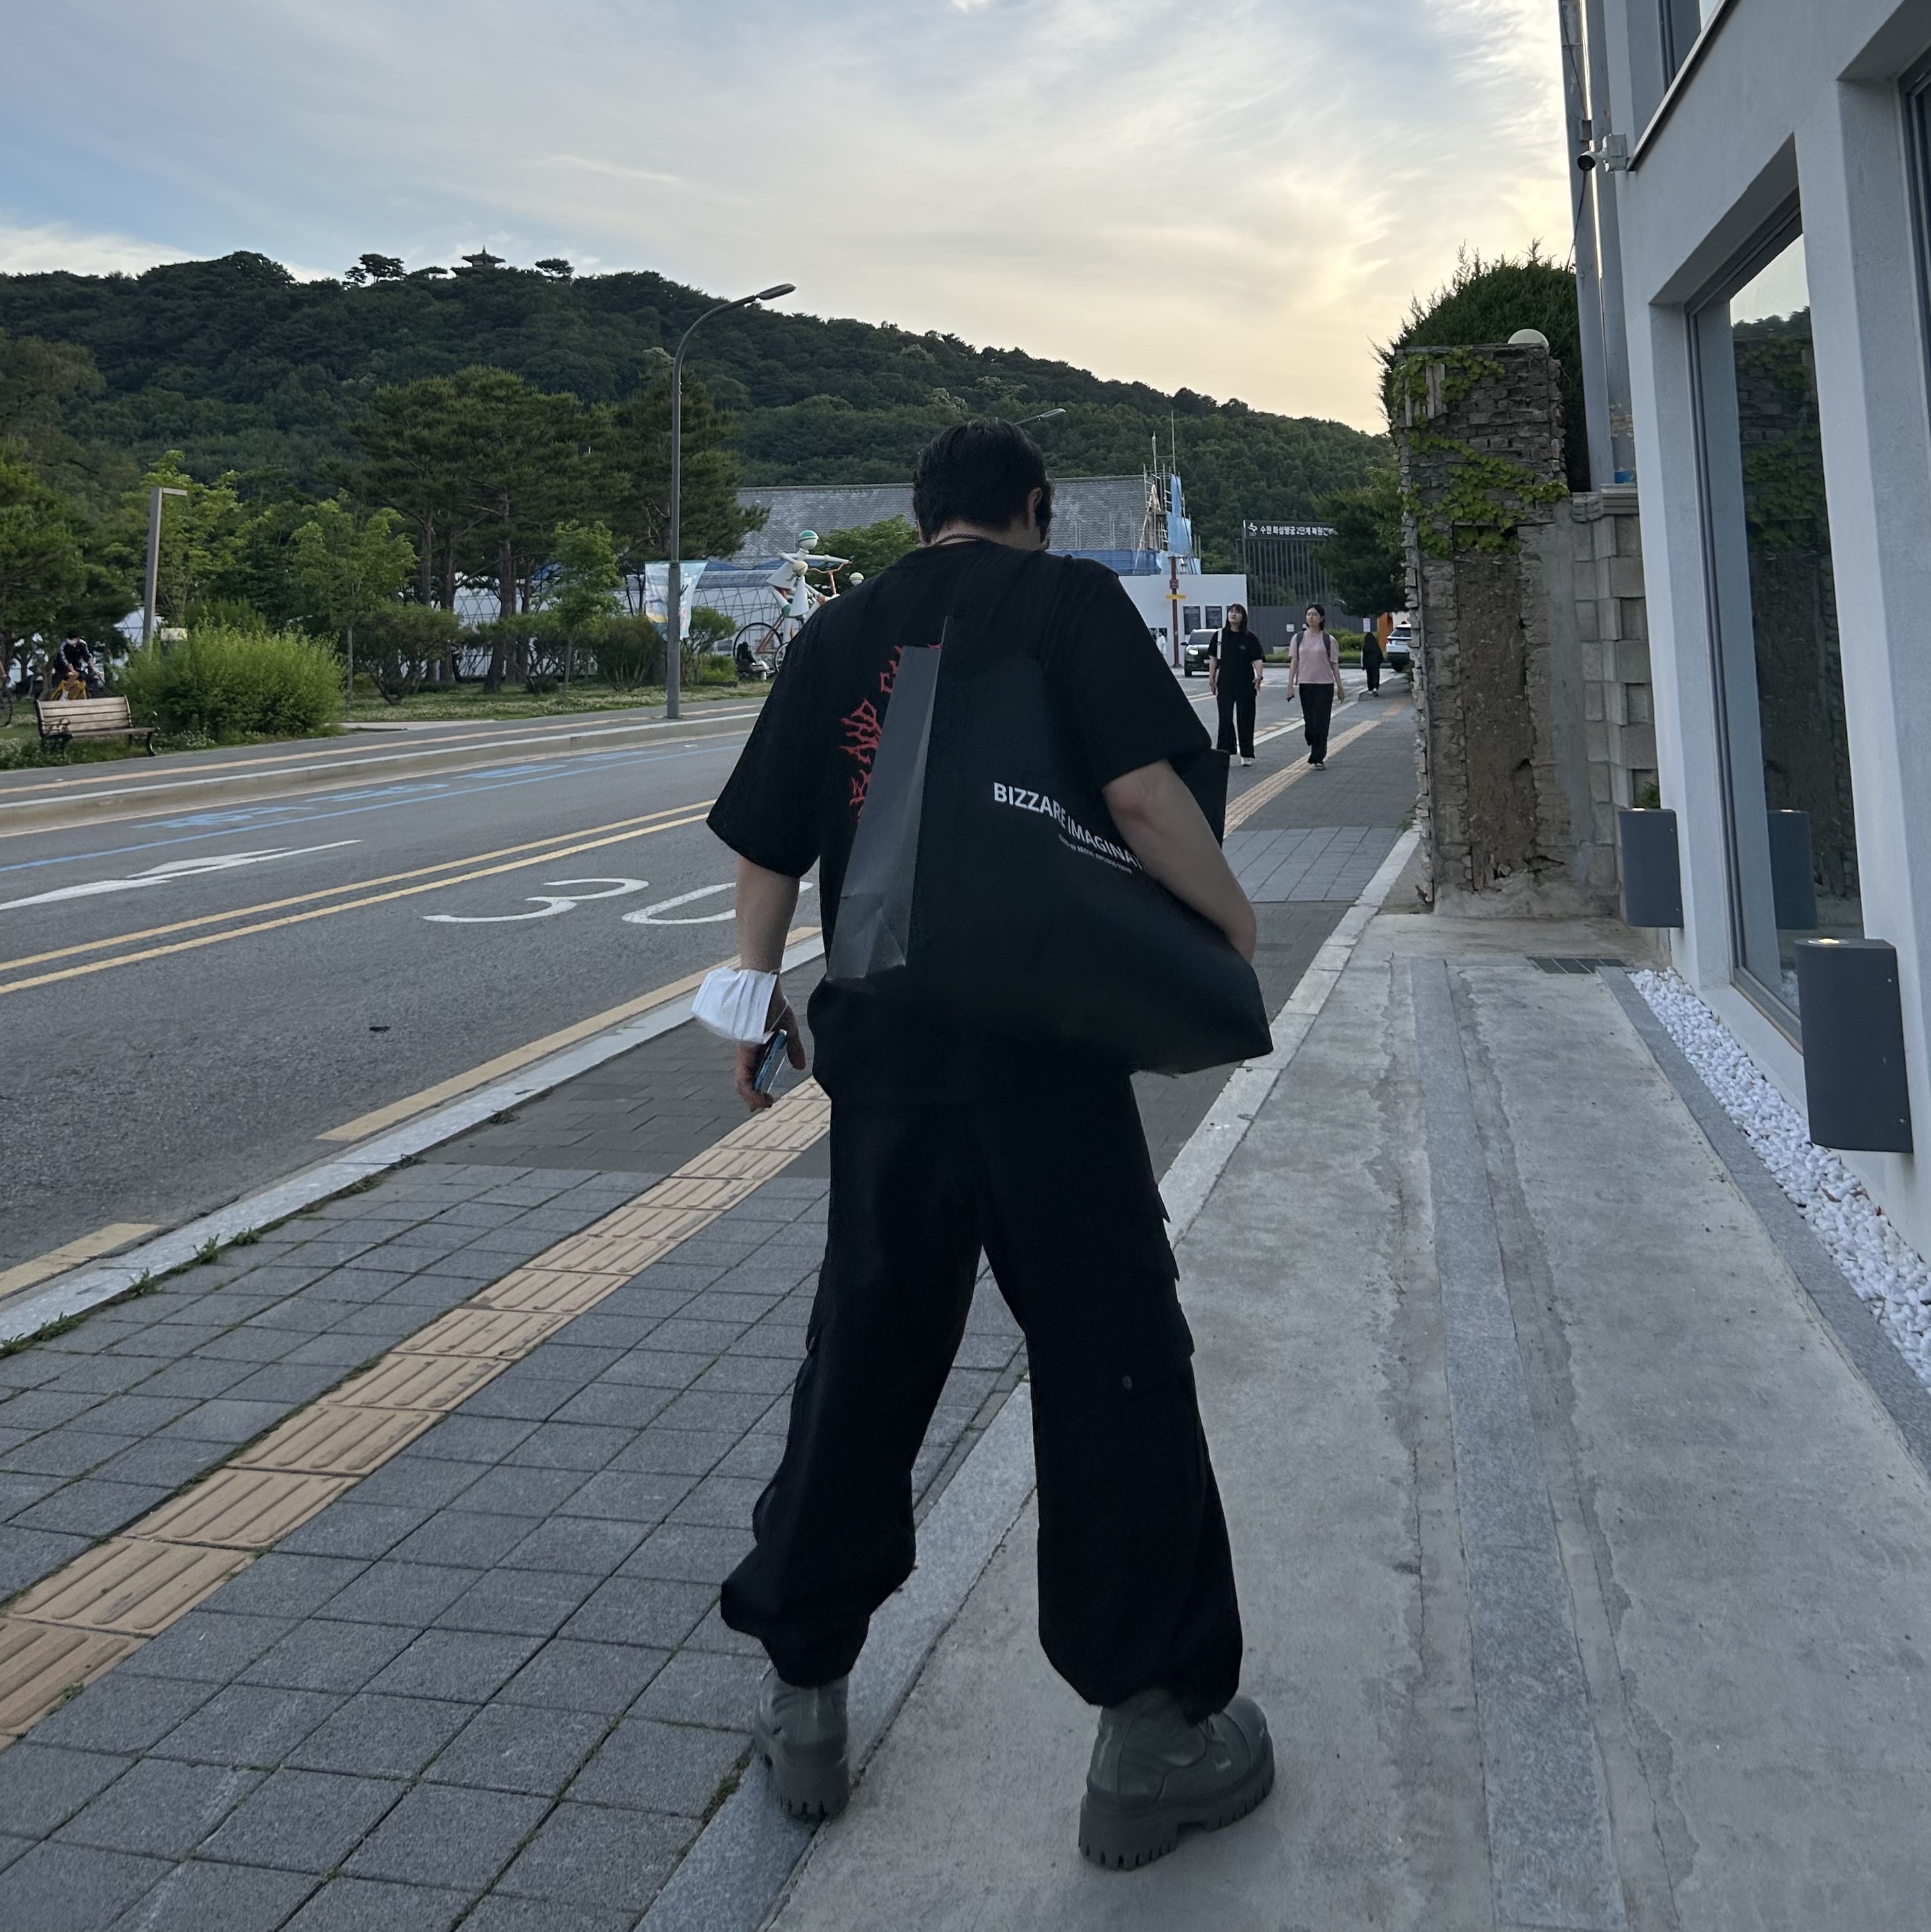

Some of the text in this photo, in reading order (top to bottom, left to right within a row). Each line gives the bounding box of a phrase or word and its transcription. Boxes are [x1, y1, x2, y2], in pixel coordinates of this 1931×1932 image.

[1260, 525, 1272, 534] 수원
[1273, 525, 1296, 535] 화성행궁
[1296, 526, 1311, 536] 2단계
[993, 782, 1067, 829] BIZZARE
[1067, 815, 1144, 871] IMAGINAT
[422, 878, 814, 925] 30
